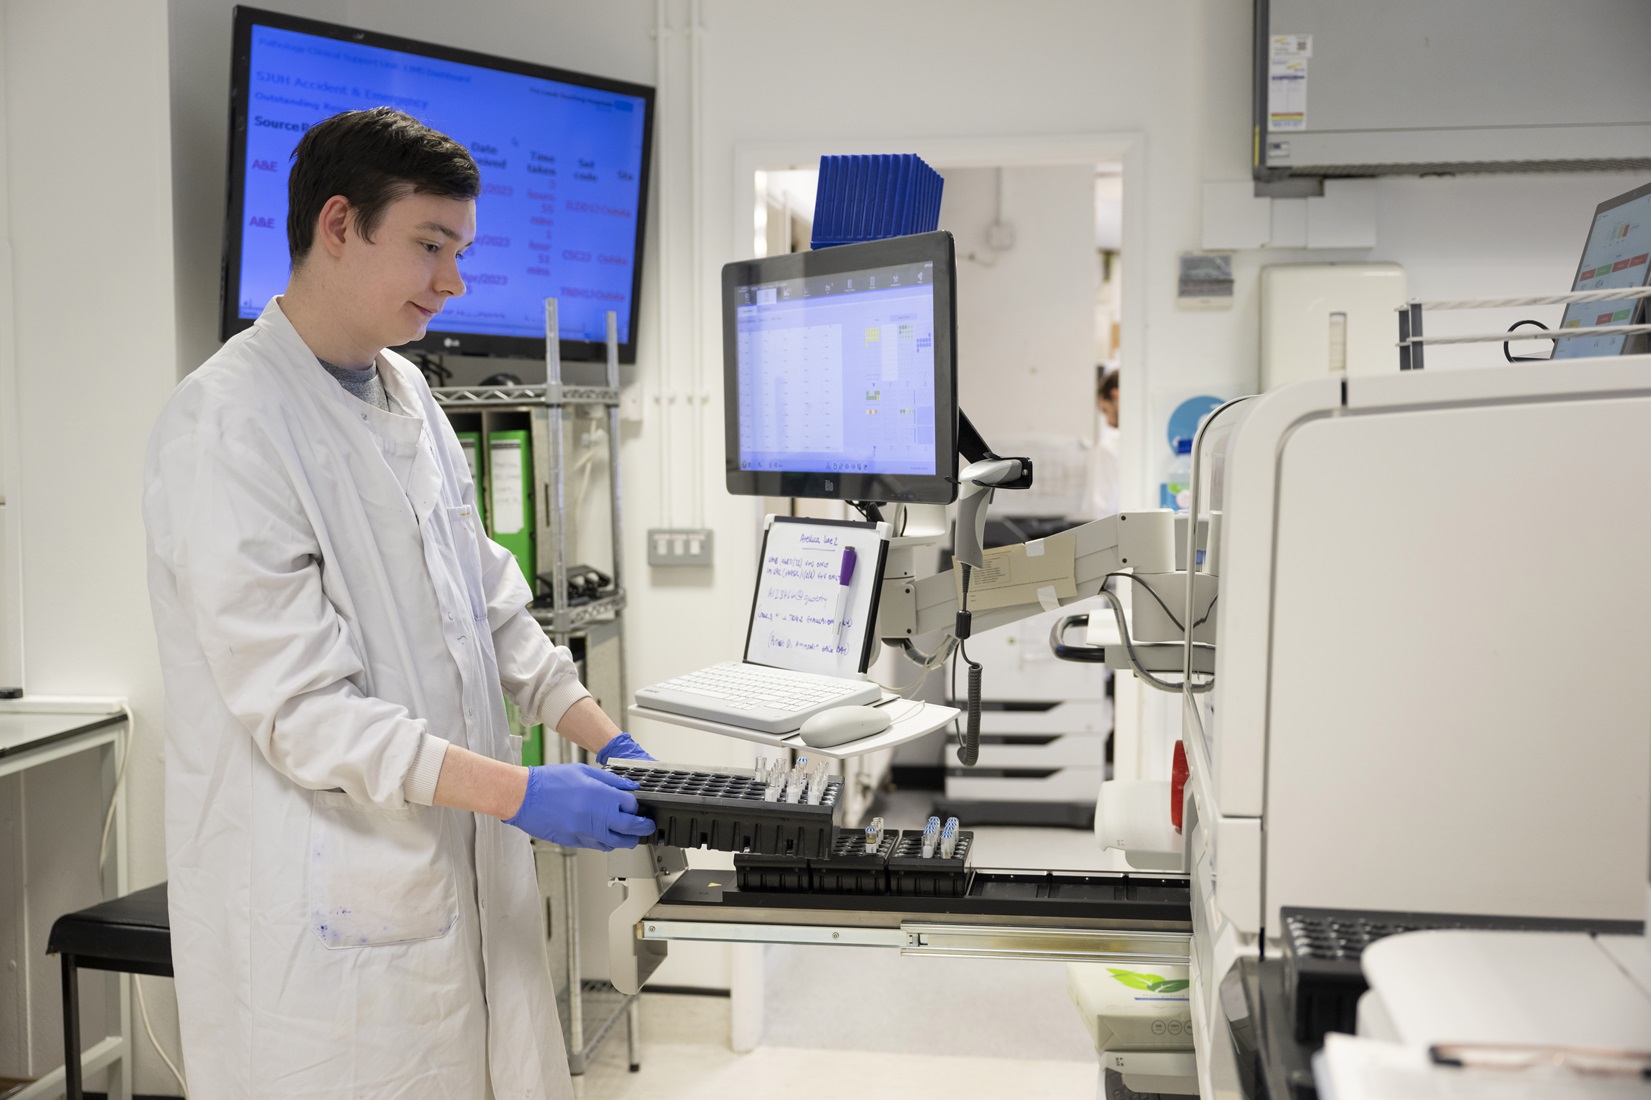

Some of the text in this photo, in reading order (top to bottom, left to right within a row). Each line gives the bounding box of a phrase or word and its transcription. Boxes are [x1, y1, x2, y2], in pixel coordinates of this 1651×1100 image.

[255, 91, 319, 110] Outstanding
[294, 77, 348, 96] Accident
[352, 87, 361, 98] &
[365, 89, 429, 110] Emergency
[254, 115, 299, 132] Source
[252, 159, 277, 172] A&E
[249, 216, 275, 229] A&E
